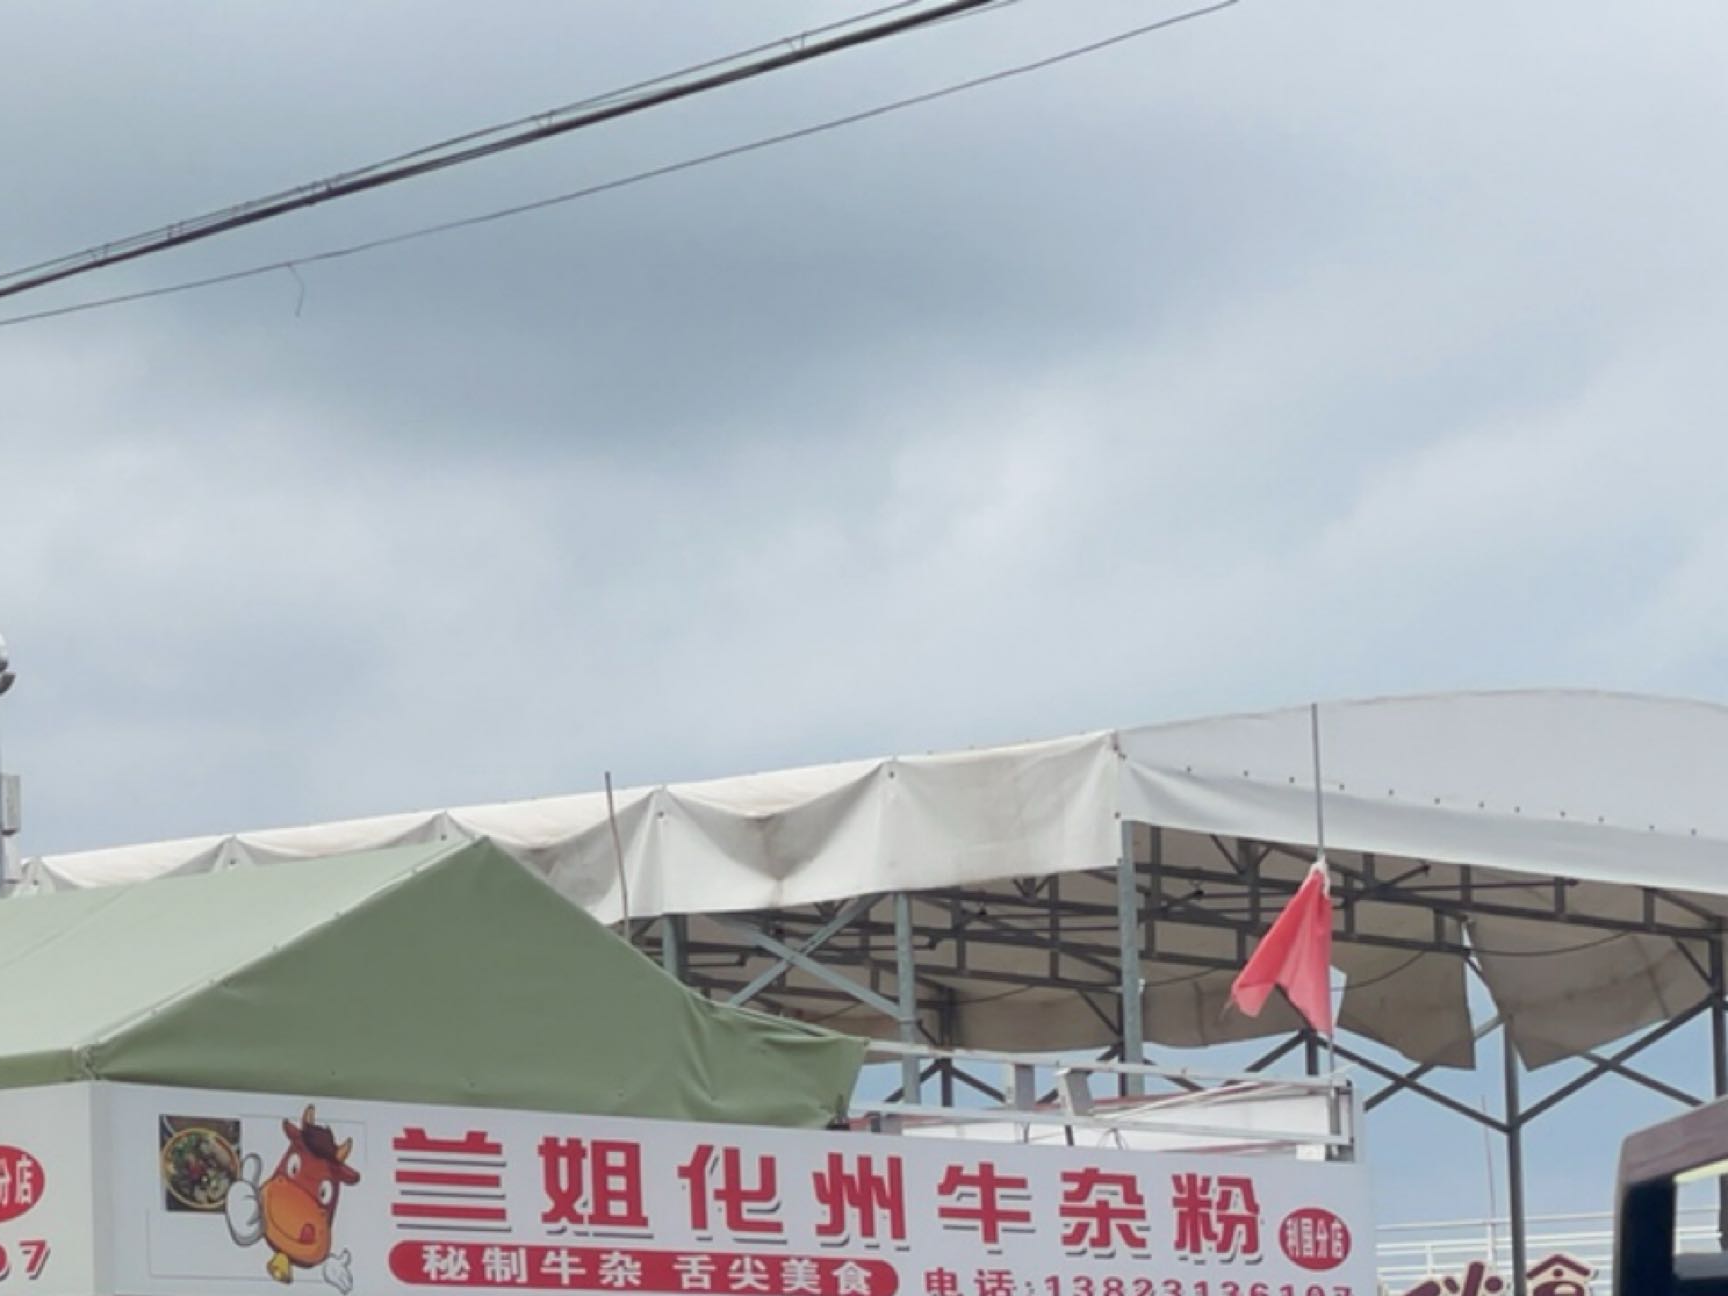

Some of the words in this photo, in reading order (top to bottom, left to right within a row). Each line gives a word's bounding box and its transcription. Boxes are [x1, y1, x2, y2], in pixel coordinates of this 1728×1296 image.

[391, 1127, 1261, 1256] 兰姐化州牛杂粉
[422, 1244, 642, 1287] 秘制牛杂
[675, 1254, 873, 1296] 舌尖美食
